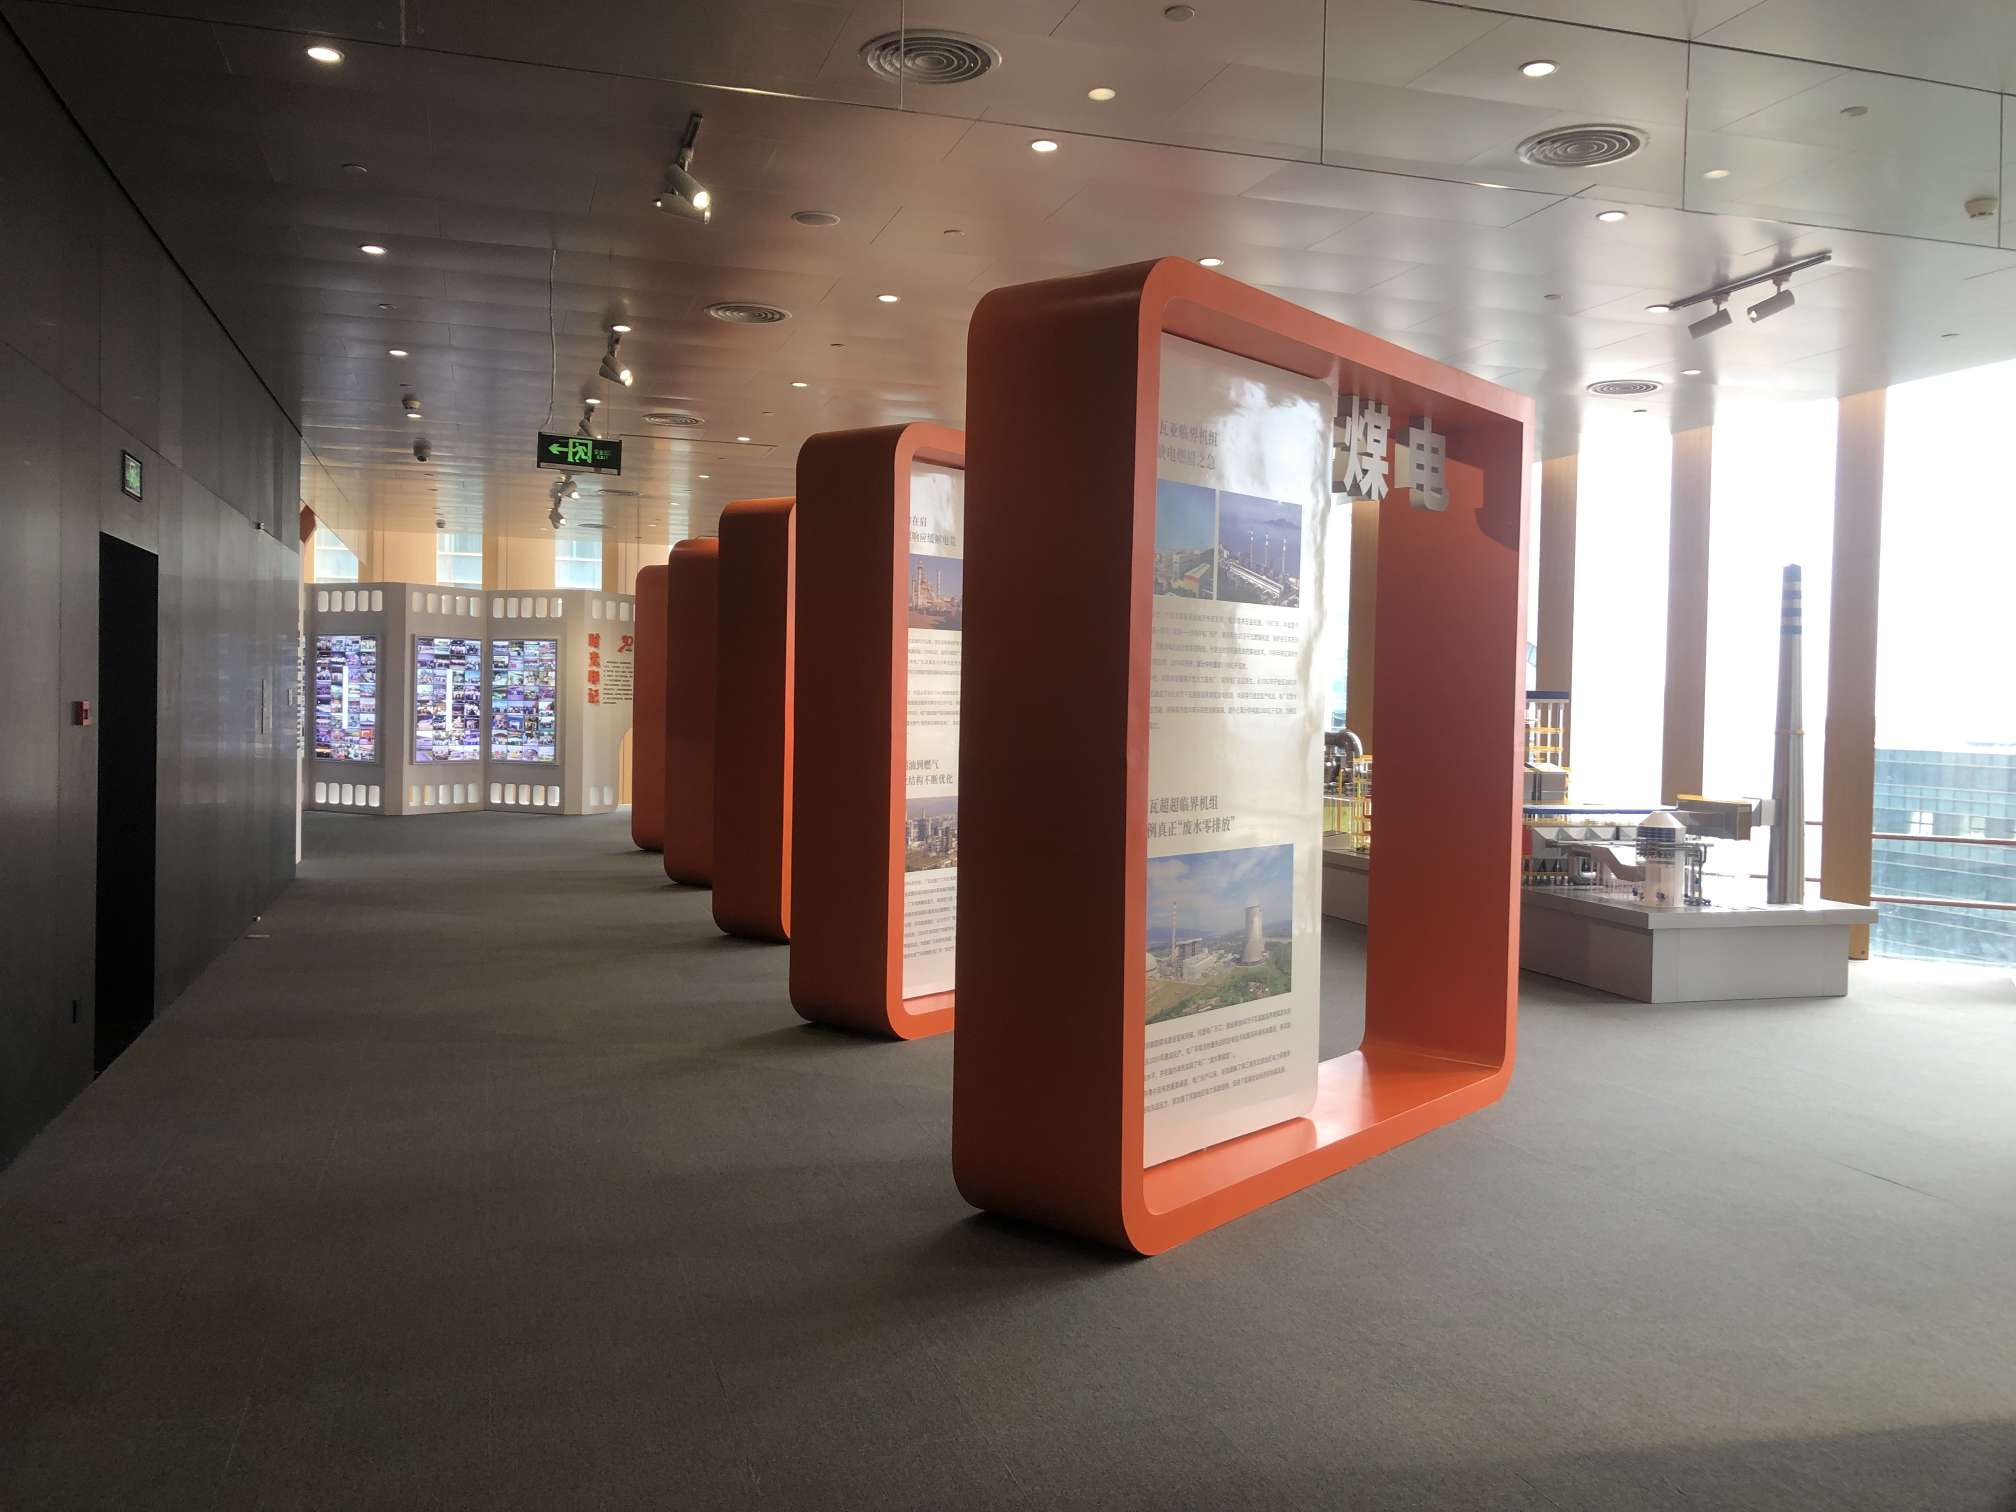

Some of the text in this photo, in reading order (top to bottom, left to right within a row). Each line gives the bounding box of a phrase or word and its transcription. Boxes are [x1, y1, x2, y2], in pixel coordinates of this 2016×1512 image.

[1341, 394, 1449, 512] 煤电
[1150, 795, 1219, 814] 瓦超超临界机组
